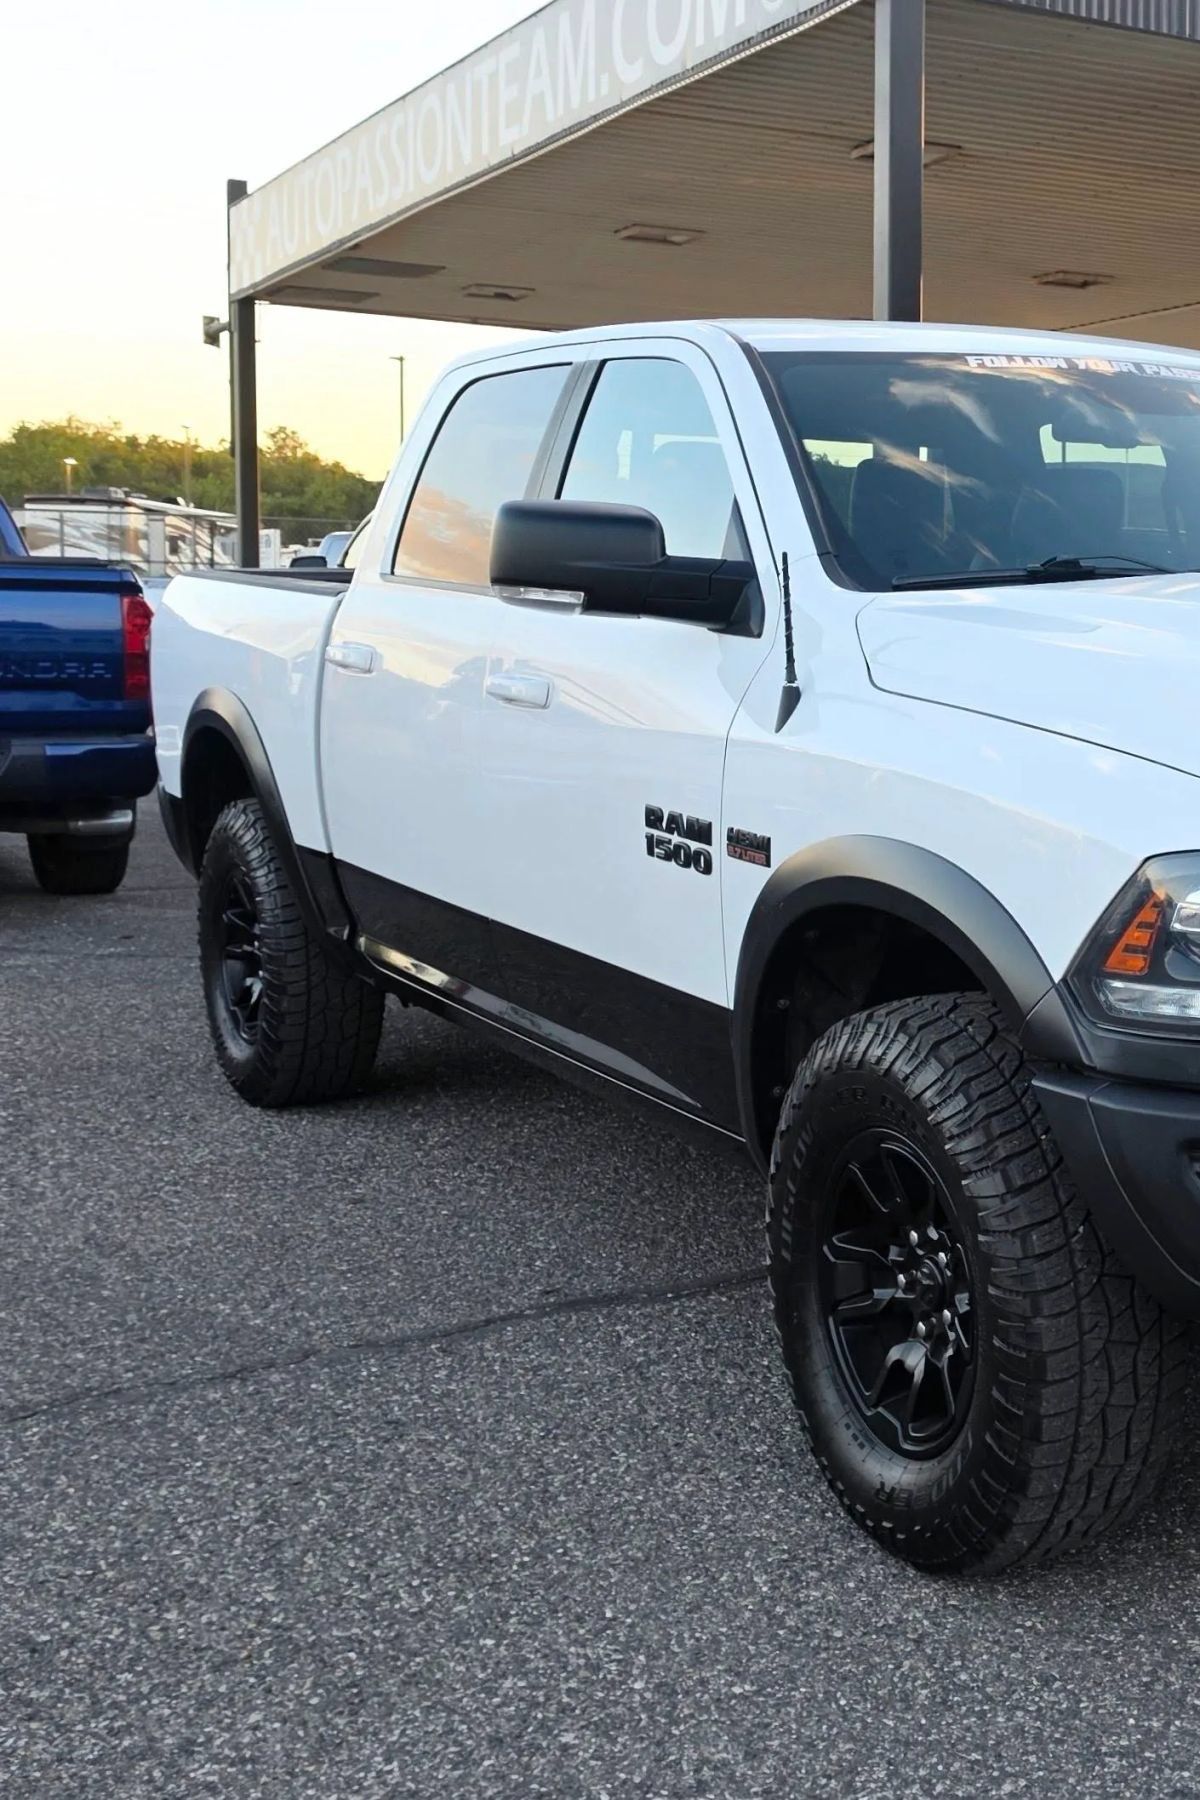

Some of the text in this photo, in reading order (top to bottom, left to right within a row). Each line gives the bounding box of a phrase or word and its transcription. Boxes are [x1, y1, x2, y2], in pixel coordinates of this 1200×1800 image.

[966, 355, 1069, 370] FOLLOW
[1070, 359, 1138, 374] YOUR
[0, 661, 112, 679] NDRA
[644, 803, 713, 847] RAM
[727, 828, 769, 850] HEMI
[644, 832, 714, 876] 1500
[743, 849, 767, 866] LITER
